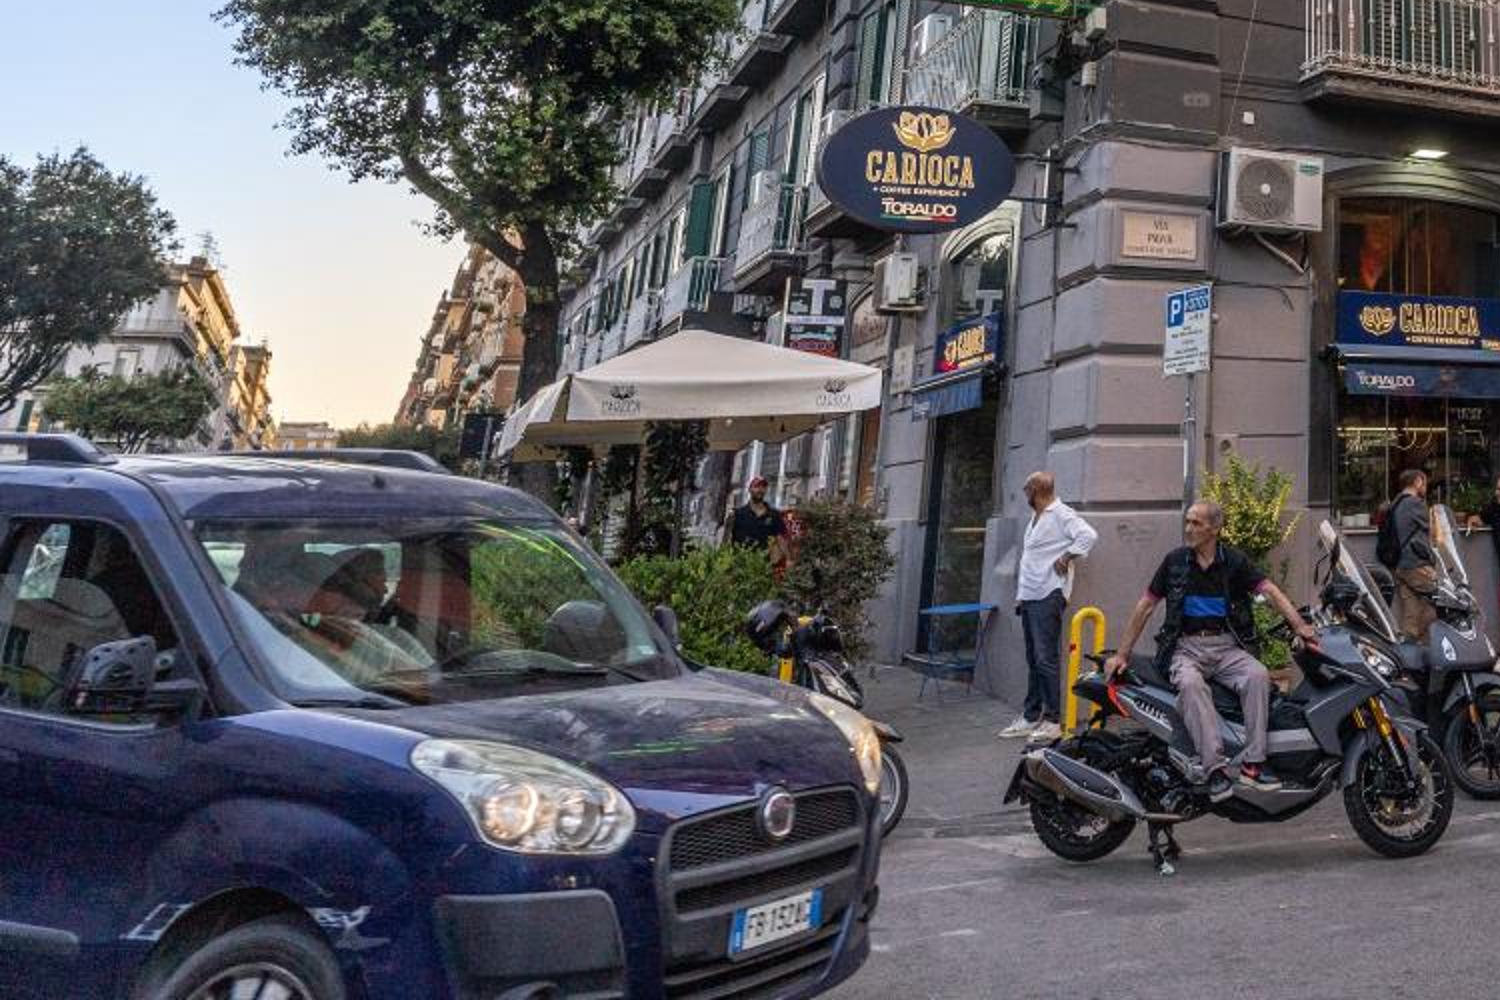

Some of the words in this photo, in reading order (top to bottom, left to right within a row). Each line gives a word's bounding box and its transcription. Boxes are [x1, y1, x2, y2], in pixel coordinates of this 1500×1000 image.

[865, 150, 975, 189] CARIOCA
[882, 201, 957, 217] TORALDO
[1171, 299, 1181, 324] P
[1400, 303, 1481, 337] CARIOCA
[1358, 374, 1415, 388] TORALDO
